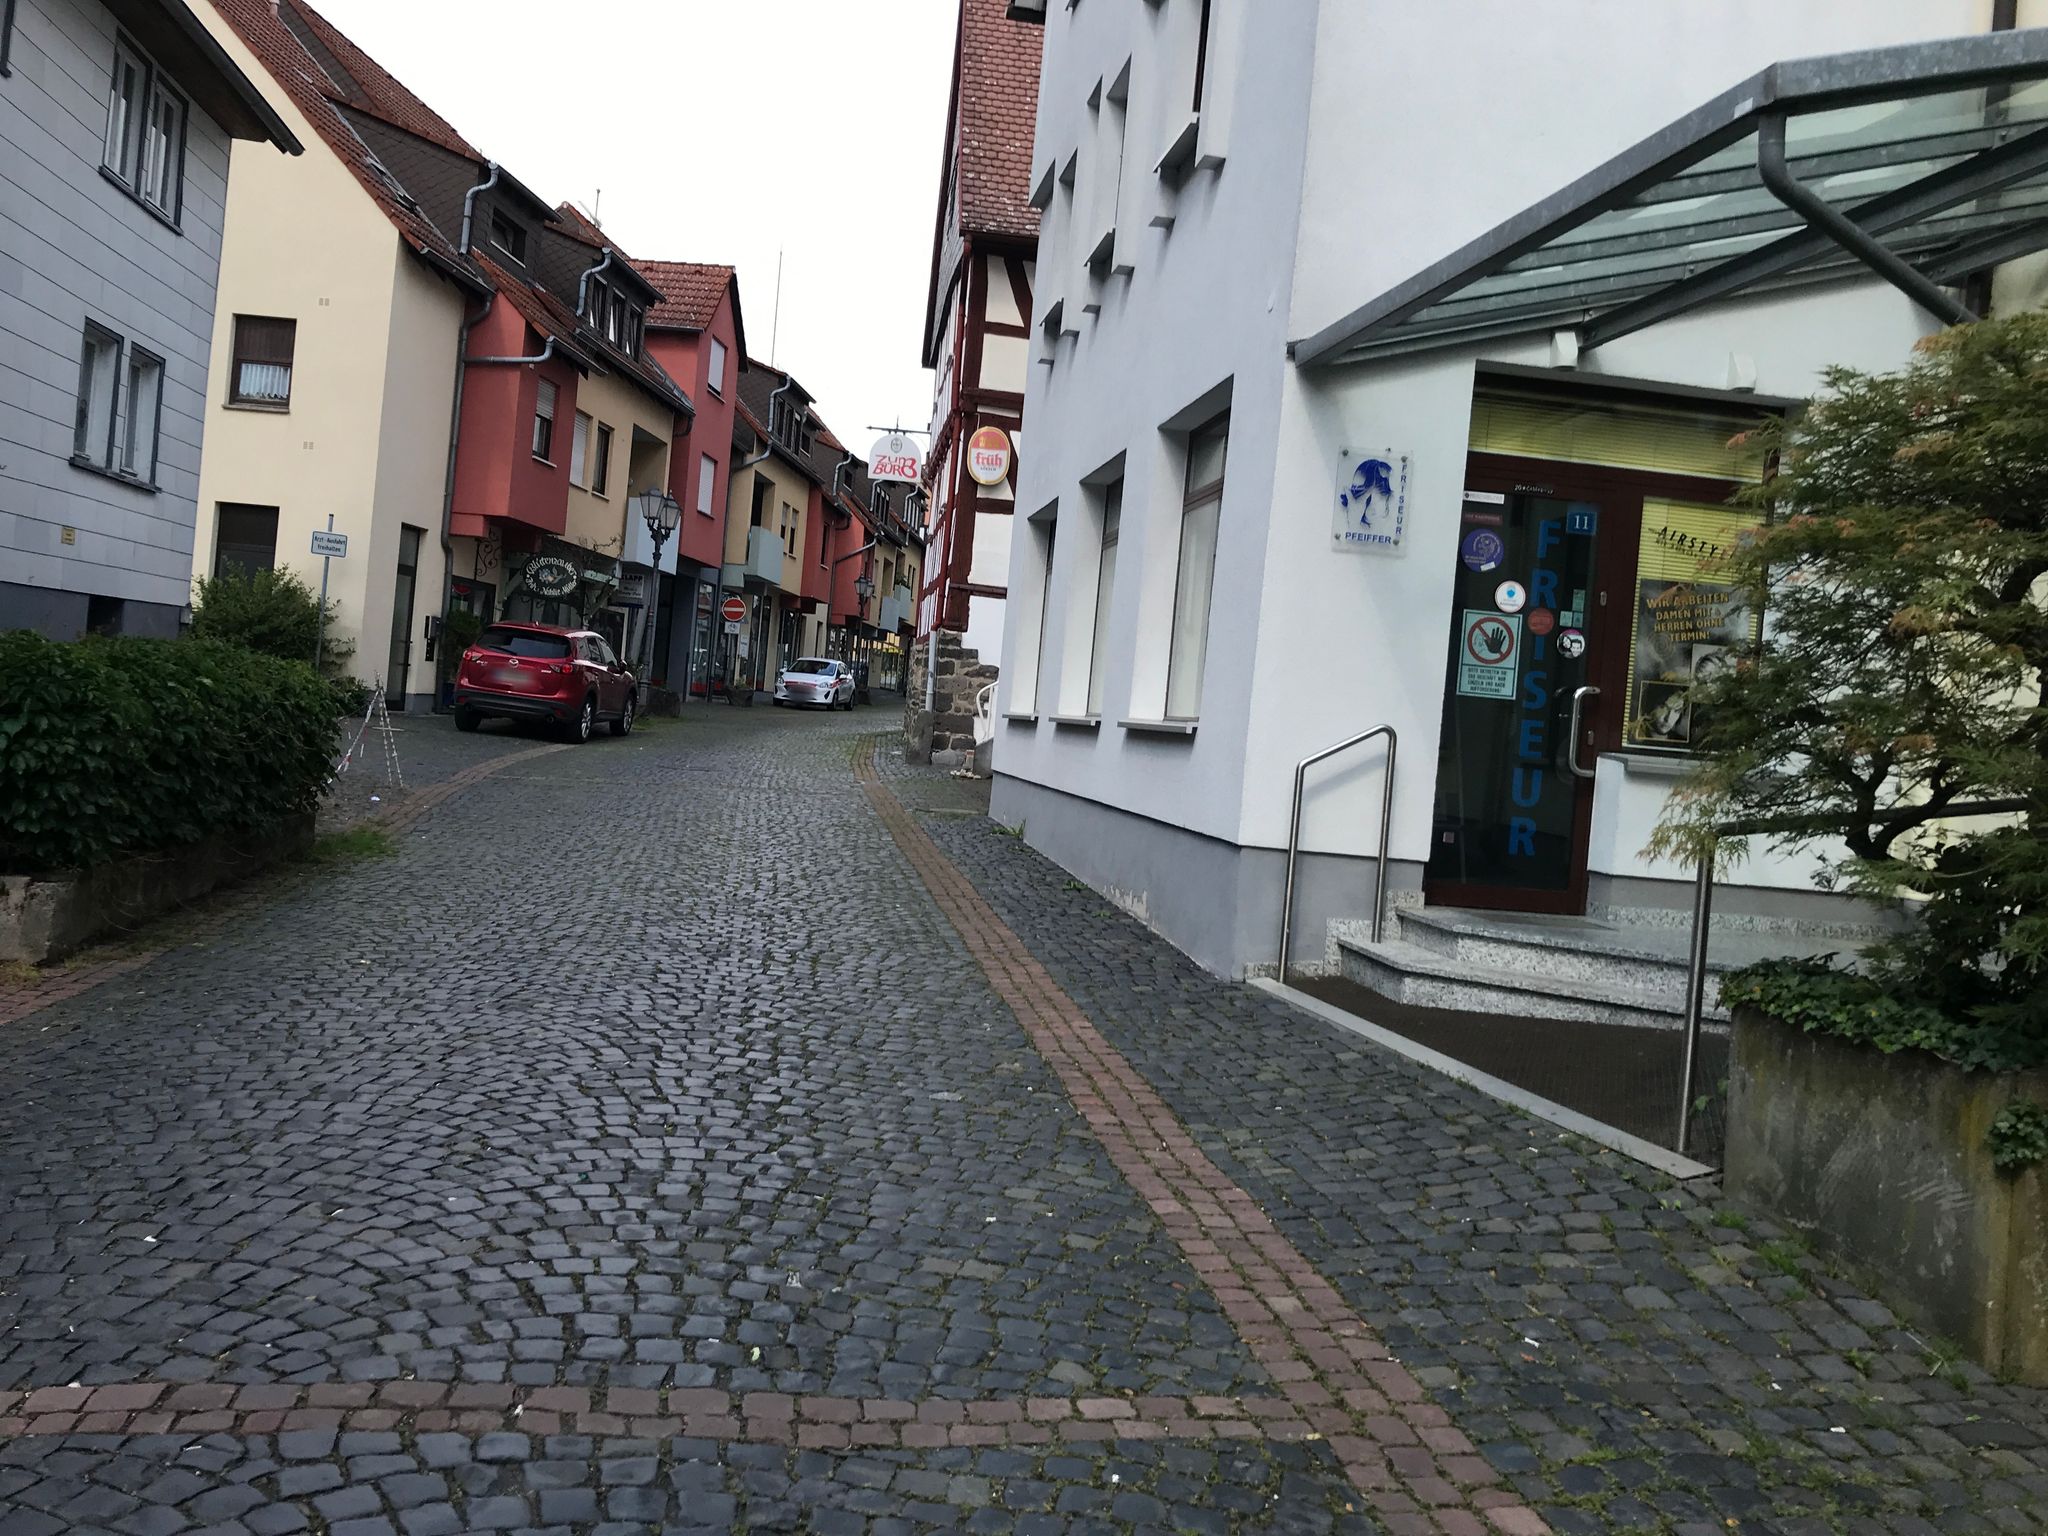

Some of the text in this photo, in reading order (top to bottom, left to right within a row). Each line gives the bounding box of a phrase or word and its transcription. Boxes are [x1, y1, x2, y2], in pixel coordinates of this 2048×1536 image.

[975, 452, 1002, 467] früh
[1395, 464, 1408, 535] FRISEUR
[1574, 515, 1589, 530] 11
[1345, 531, 1392, 544] PFEIFFER
[1646, 597, 1670, 609] WIR
[1655, 608, 1712, 621] DAMEN MIT
[1654, 620, 1693, 632] HERREN
[1669, 631, 1711, 642] TERMIN!
[1508, 519, 1561, 857] FRISEUR
